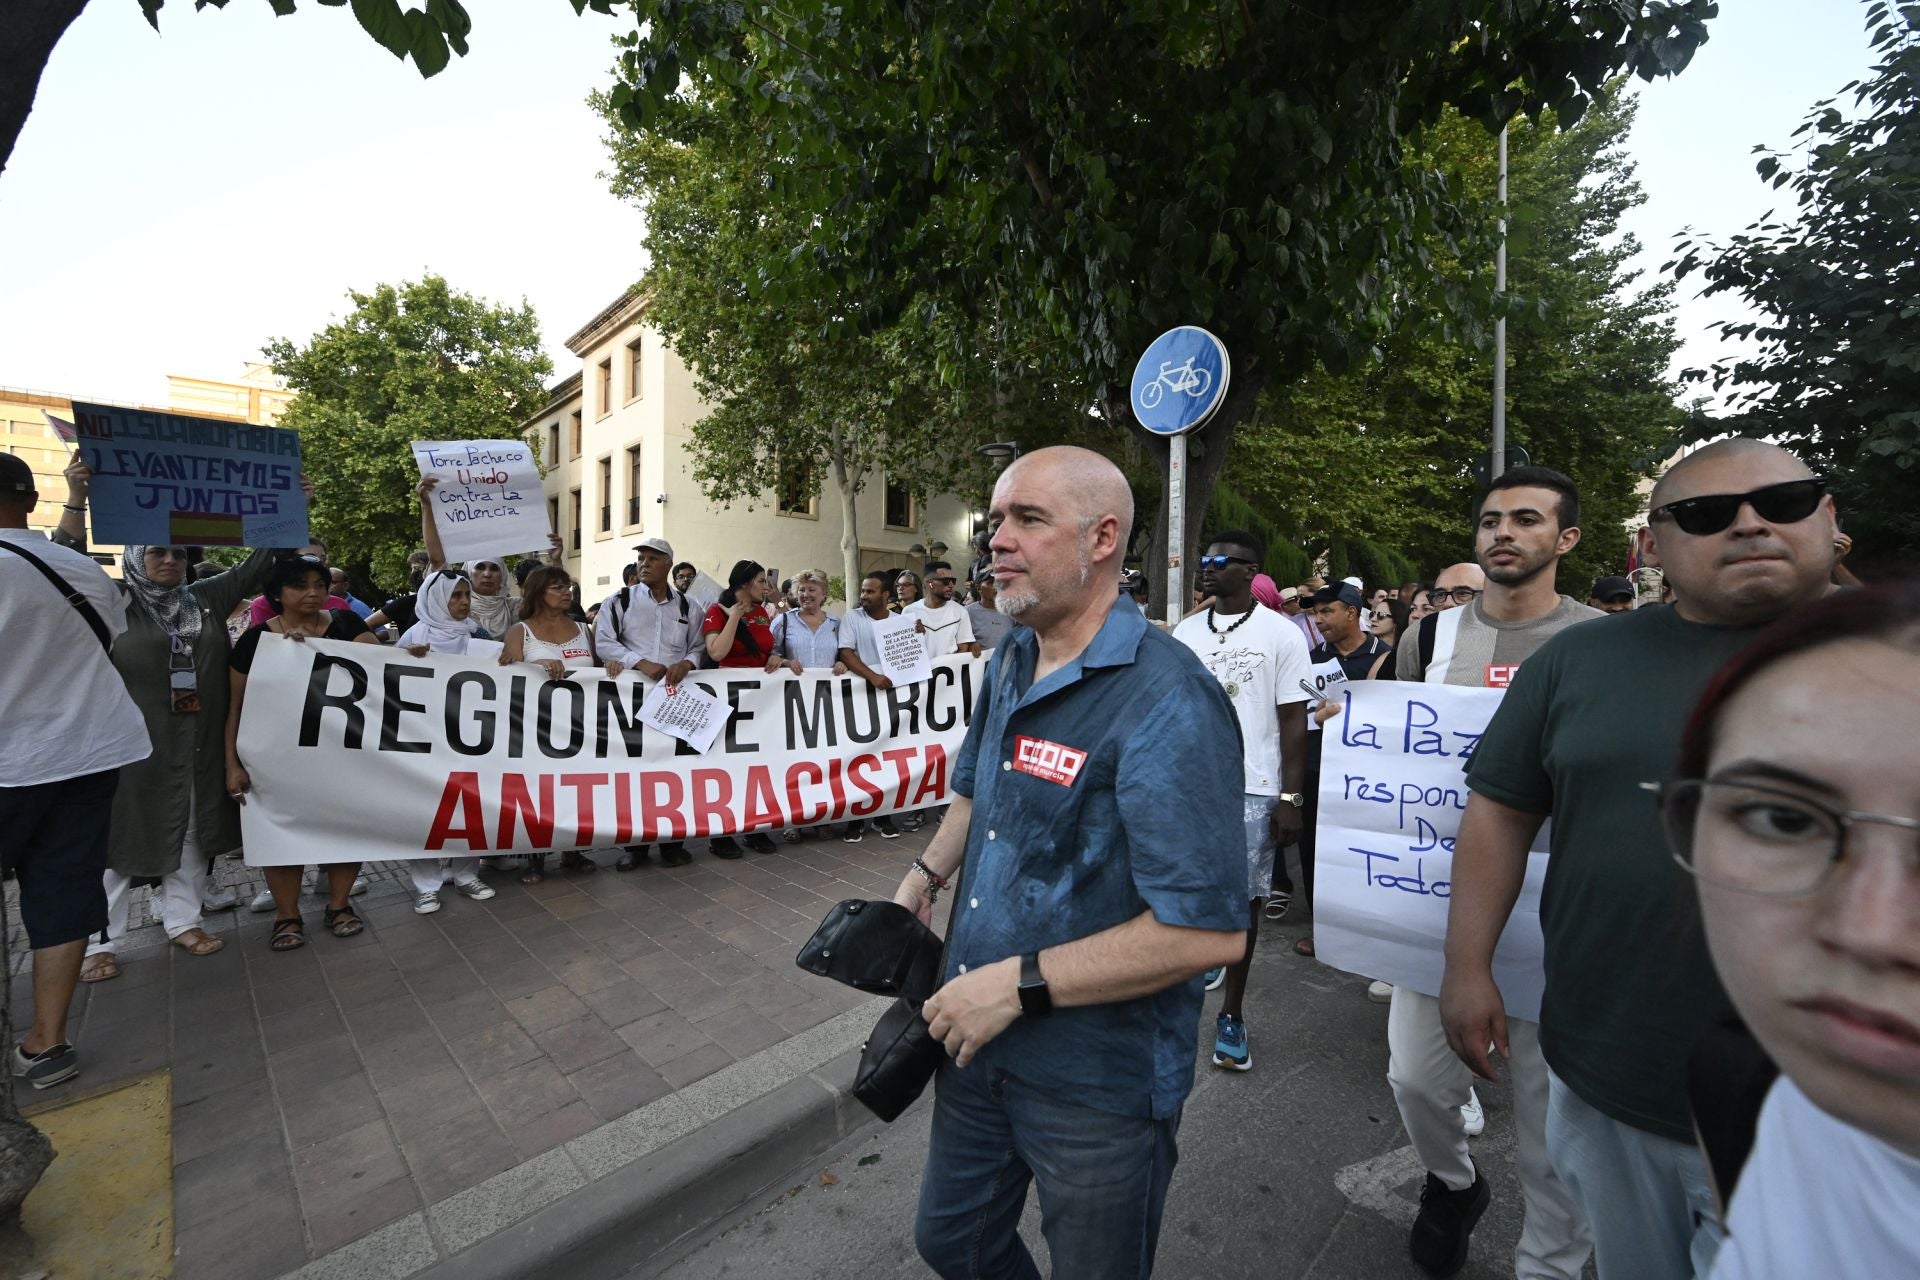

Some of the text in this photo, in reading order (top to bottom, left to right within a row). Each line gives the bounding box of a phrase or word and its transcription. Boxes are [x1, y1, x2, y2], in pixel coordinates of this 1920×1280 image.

[79, 413, 112, 439] NO
[88, 448, 292, 490] LEVANTEMOS
[420, 446, 522, 467] Torre Pacheco
[134, 483, 279, 515] JUNTOS
[892, 628, 914, 636] IMPORTA
[892, 644, 921, 654] OSCURIDAD
[904, 649, 922, 657] SOMOS
[298, 652, 644, 759] REGIÓN
[783, 660, 990, 751] MURCI
[1404, 700, 1484, 757] Paz
[424, 744, 948, 851] ANTIRRACISTA
[1344, 774, 1471, 829] respon
